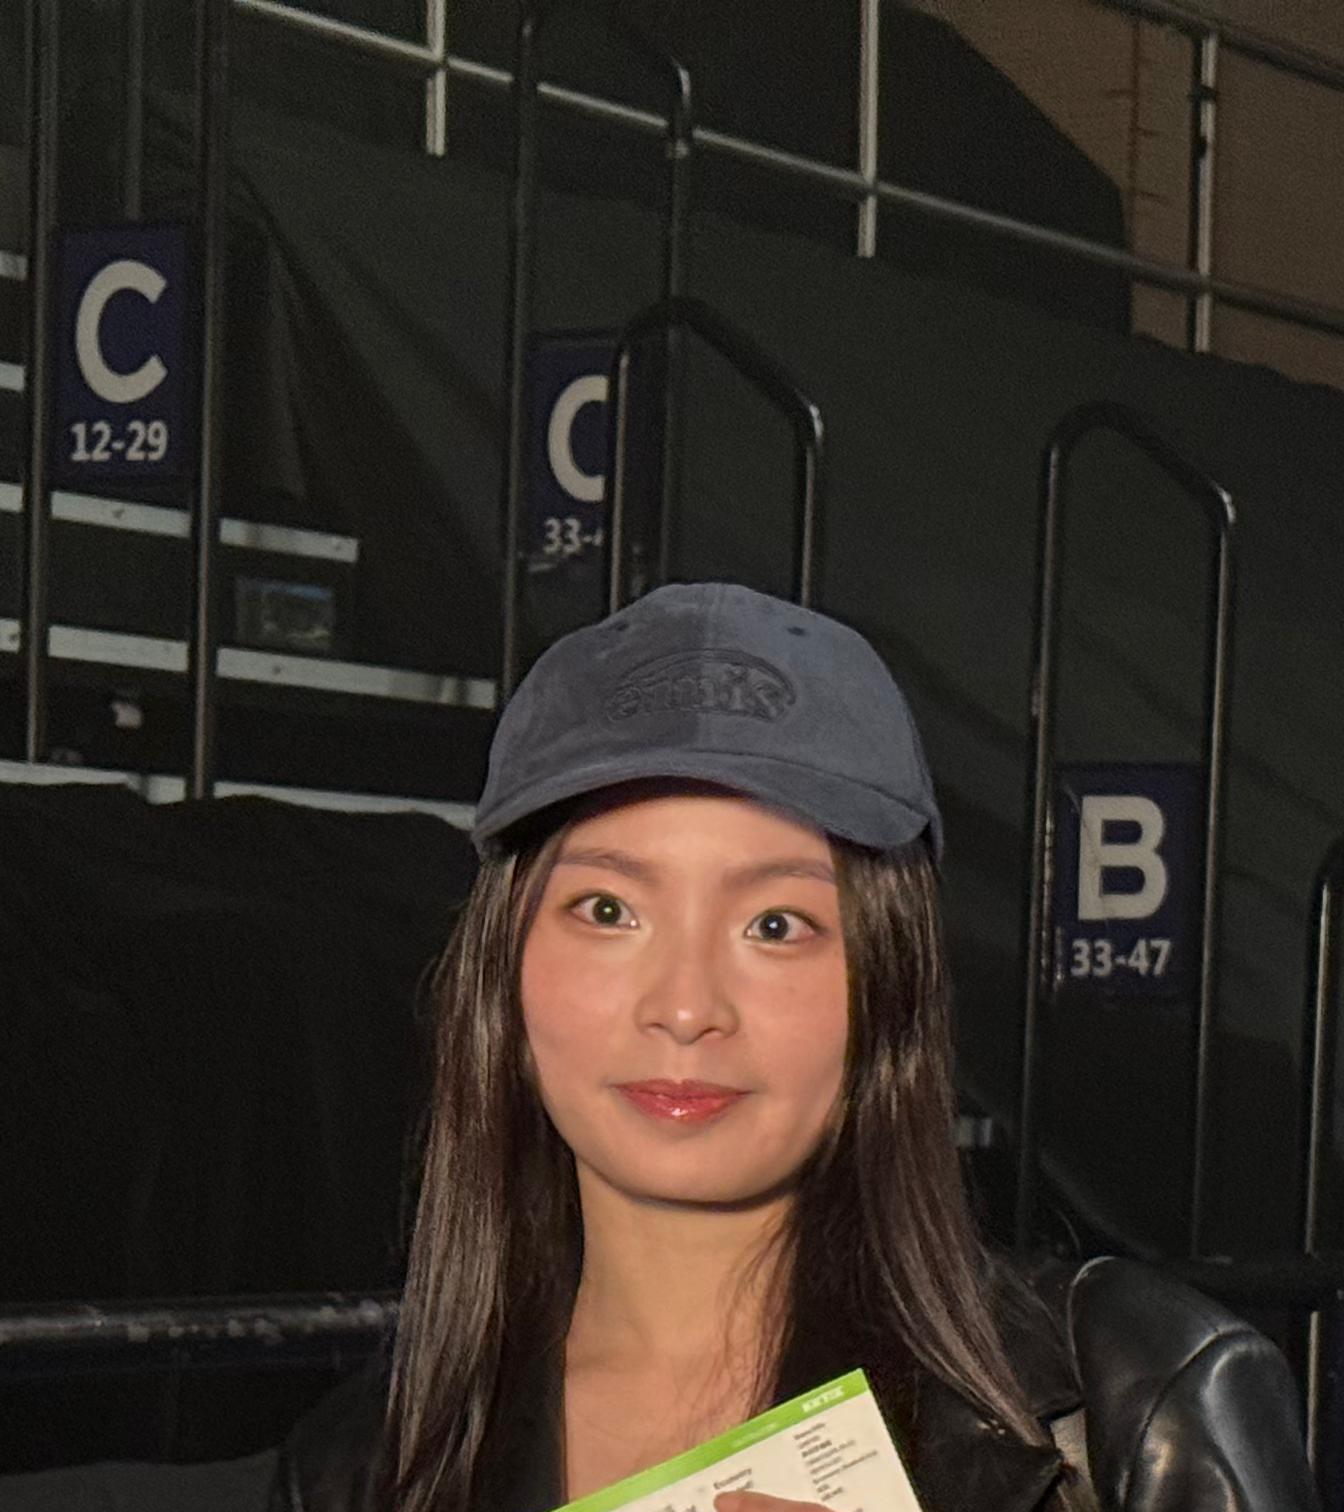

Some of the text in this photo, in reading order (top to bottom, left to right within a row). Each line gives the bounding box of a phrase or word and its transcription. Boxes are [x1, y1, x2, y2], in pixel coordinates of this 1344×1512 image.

[75, 260, 167, 403] C
[70, 420, 168, 463] 12-29
[548, 375, 608, 502] C
[1077, 795, 1168, 921] B
[1070, 938, 1173, 978] 33-47
